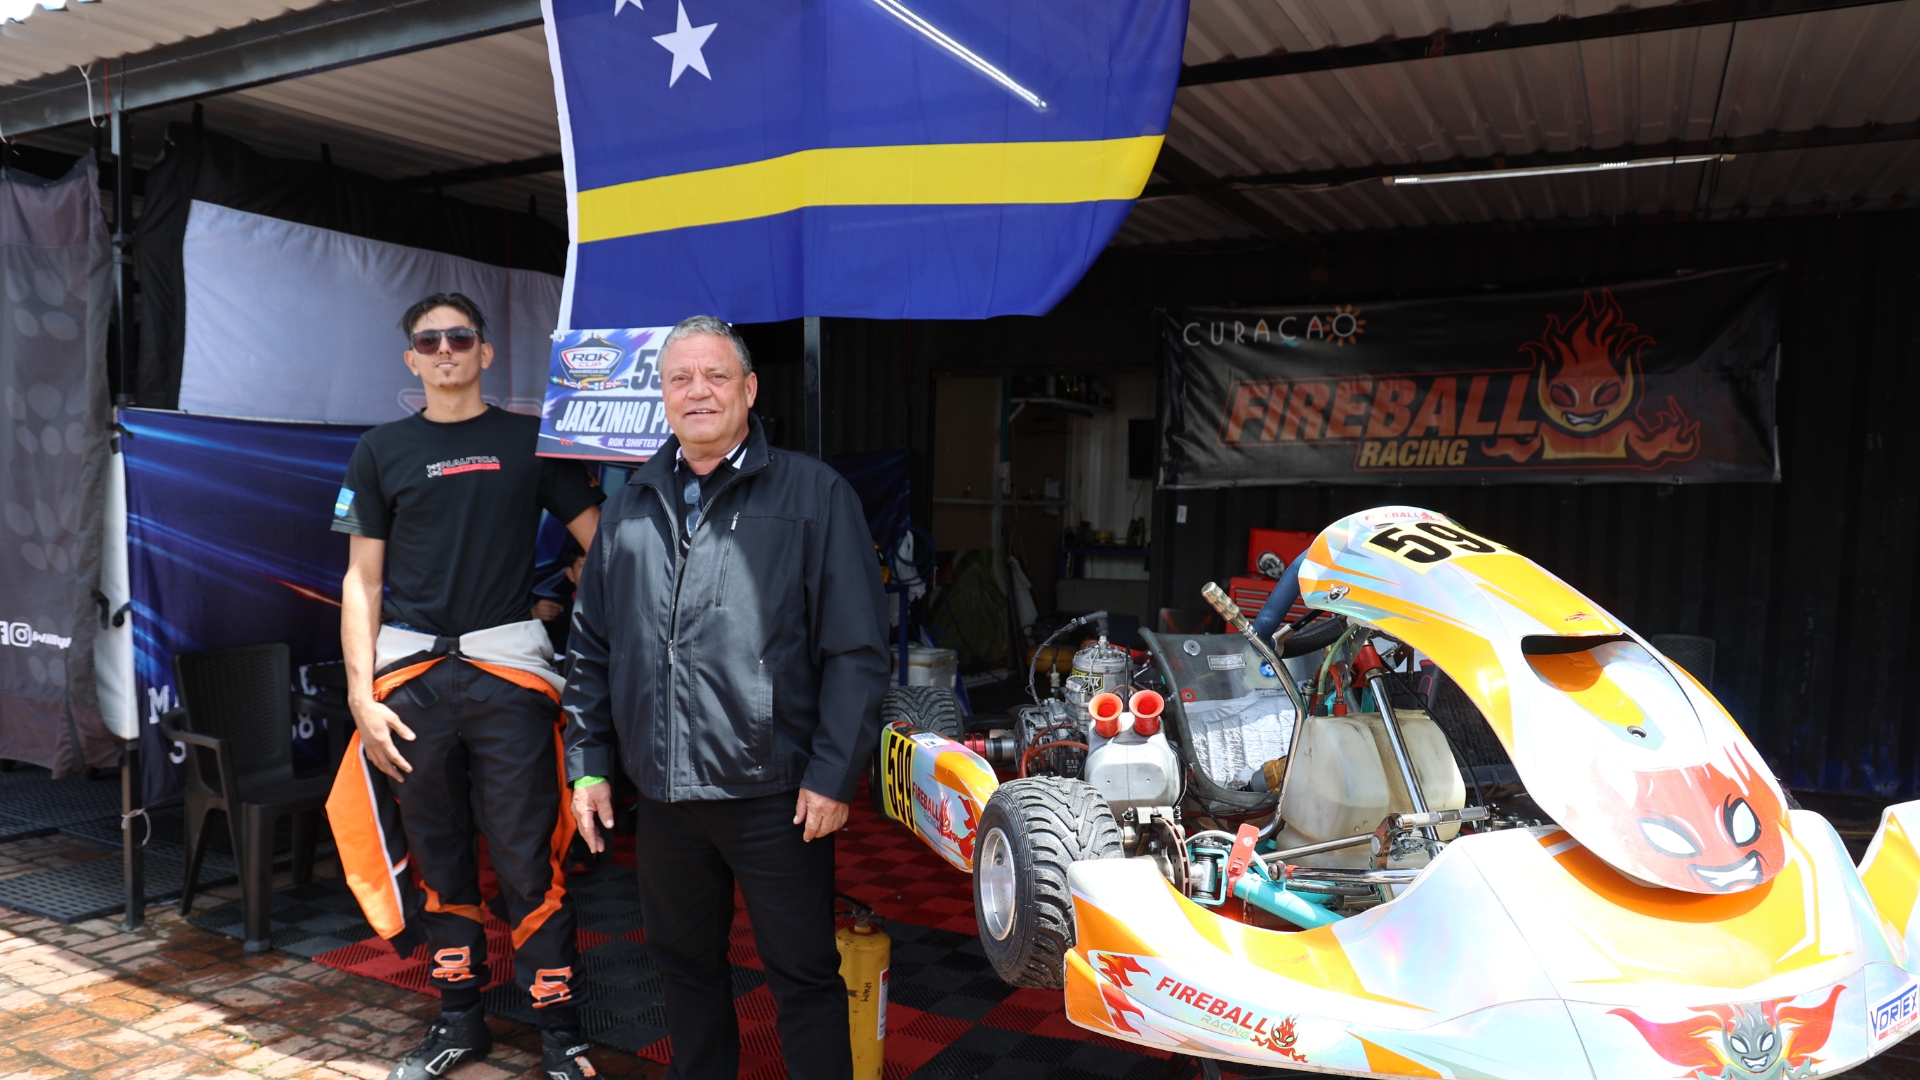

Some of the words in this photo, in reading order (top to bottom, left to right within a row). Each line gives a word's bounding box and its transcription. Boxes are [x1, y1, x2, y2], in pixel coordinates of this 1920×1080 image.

[571, 353, 611, 361] ROK
[555, 400, 651, 433] JARZINHO
[1224, 373, 1539, 442] FIREBALL
[607, 438, 625, 447] ROK
[625, 439, 658, 448] SHIFTER
[1359, 438, 1469, 467] RACING
[888, 734, 915, 831] 599
[912, 781, 940, 823] FIREBALL
[1156, 976, 1268, 1035] FIREBALL
[1870, 984, 1918, 1039] VORTEX
[1200, 1014, 1250, 1040] RACING
